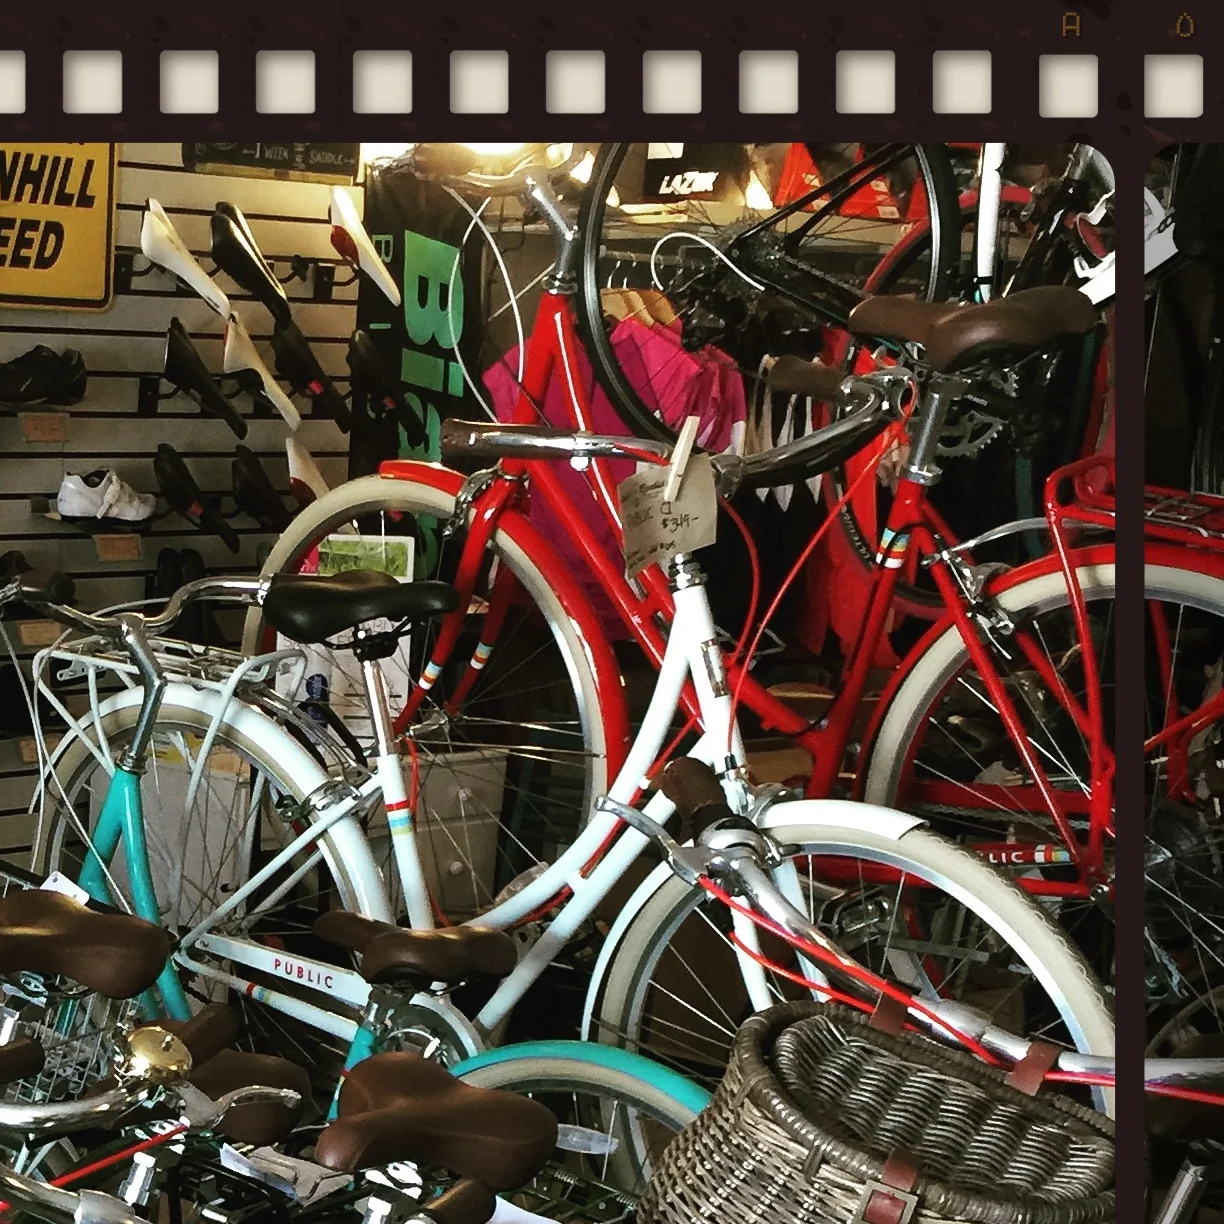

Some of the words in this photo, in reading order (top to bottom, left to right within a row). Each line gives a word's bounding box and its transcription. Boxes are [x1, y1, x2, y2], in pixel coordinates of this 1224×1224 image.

[264, 146, 289, 160] WEEK
[310, 151, 342, 165] SADDLE
[989, 851, 1024, 864] LIC
[274, 958, 333, 989] PUBLIC
